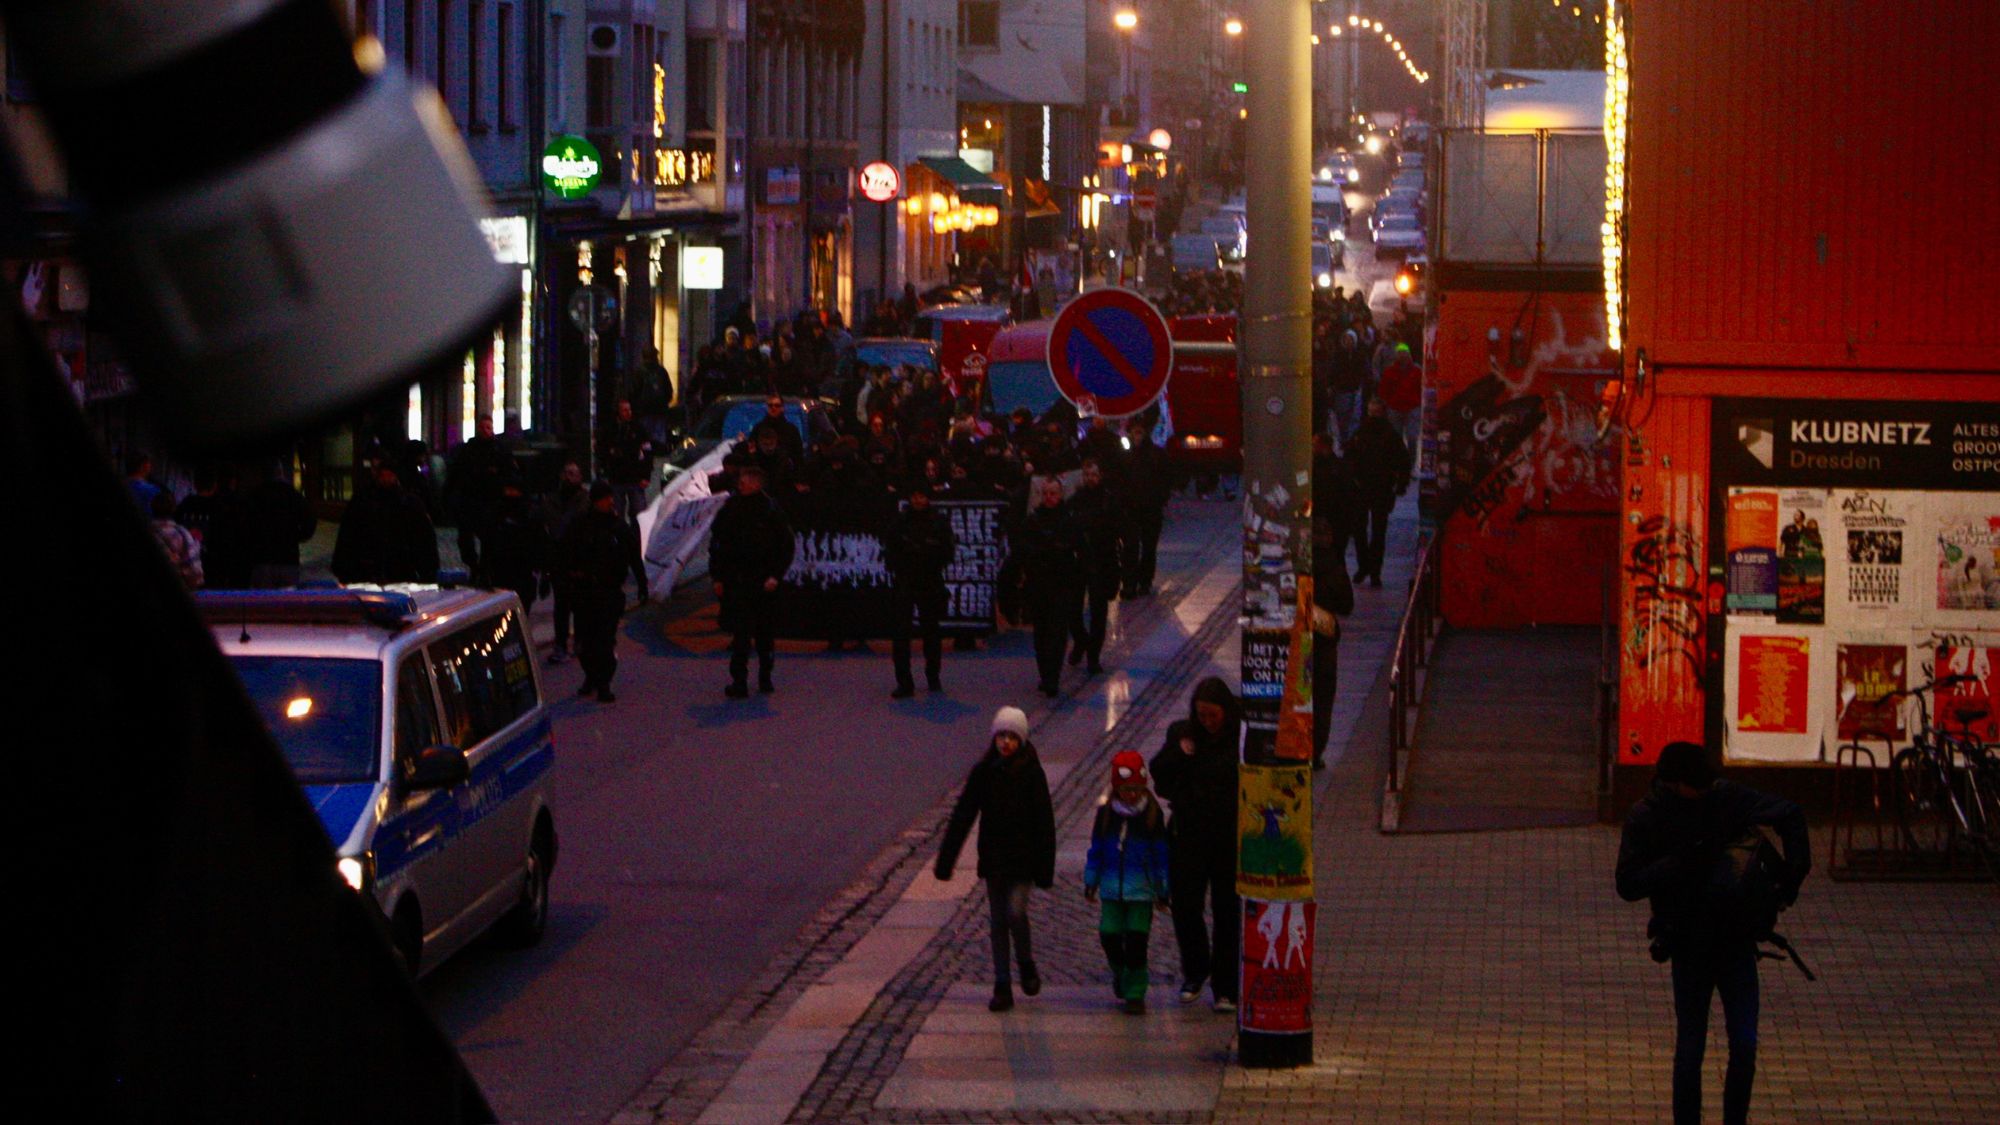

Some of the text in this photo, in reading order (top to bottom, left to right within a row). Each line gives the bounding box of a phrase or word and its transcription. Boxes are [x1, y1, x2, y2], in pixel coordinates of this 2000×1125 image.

[1790, 419, 1932, 446] KLUBNETZ
[1952, 440, 2000, 455] GROO
[1790, 451, 1881, 471] Dresden
[1253, 669, 1272, 683] ON
